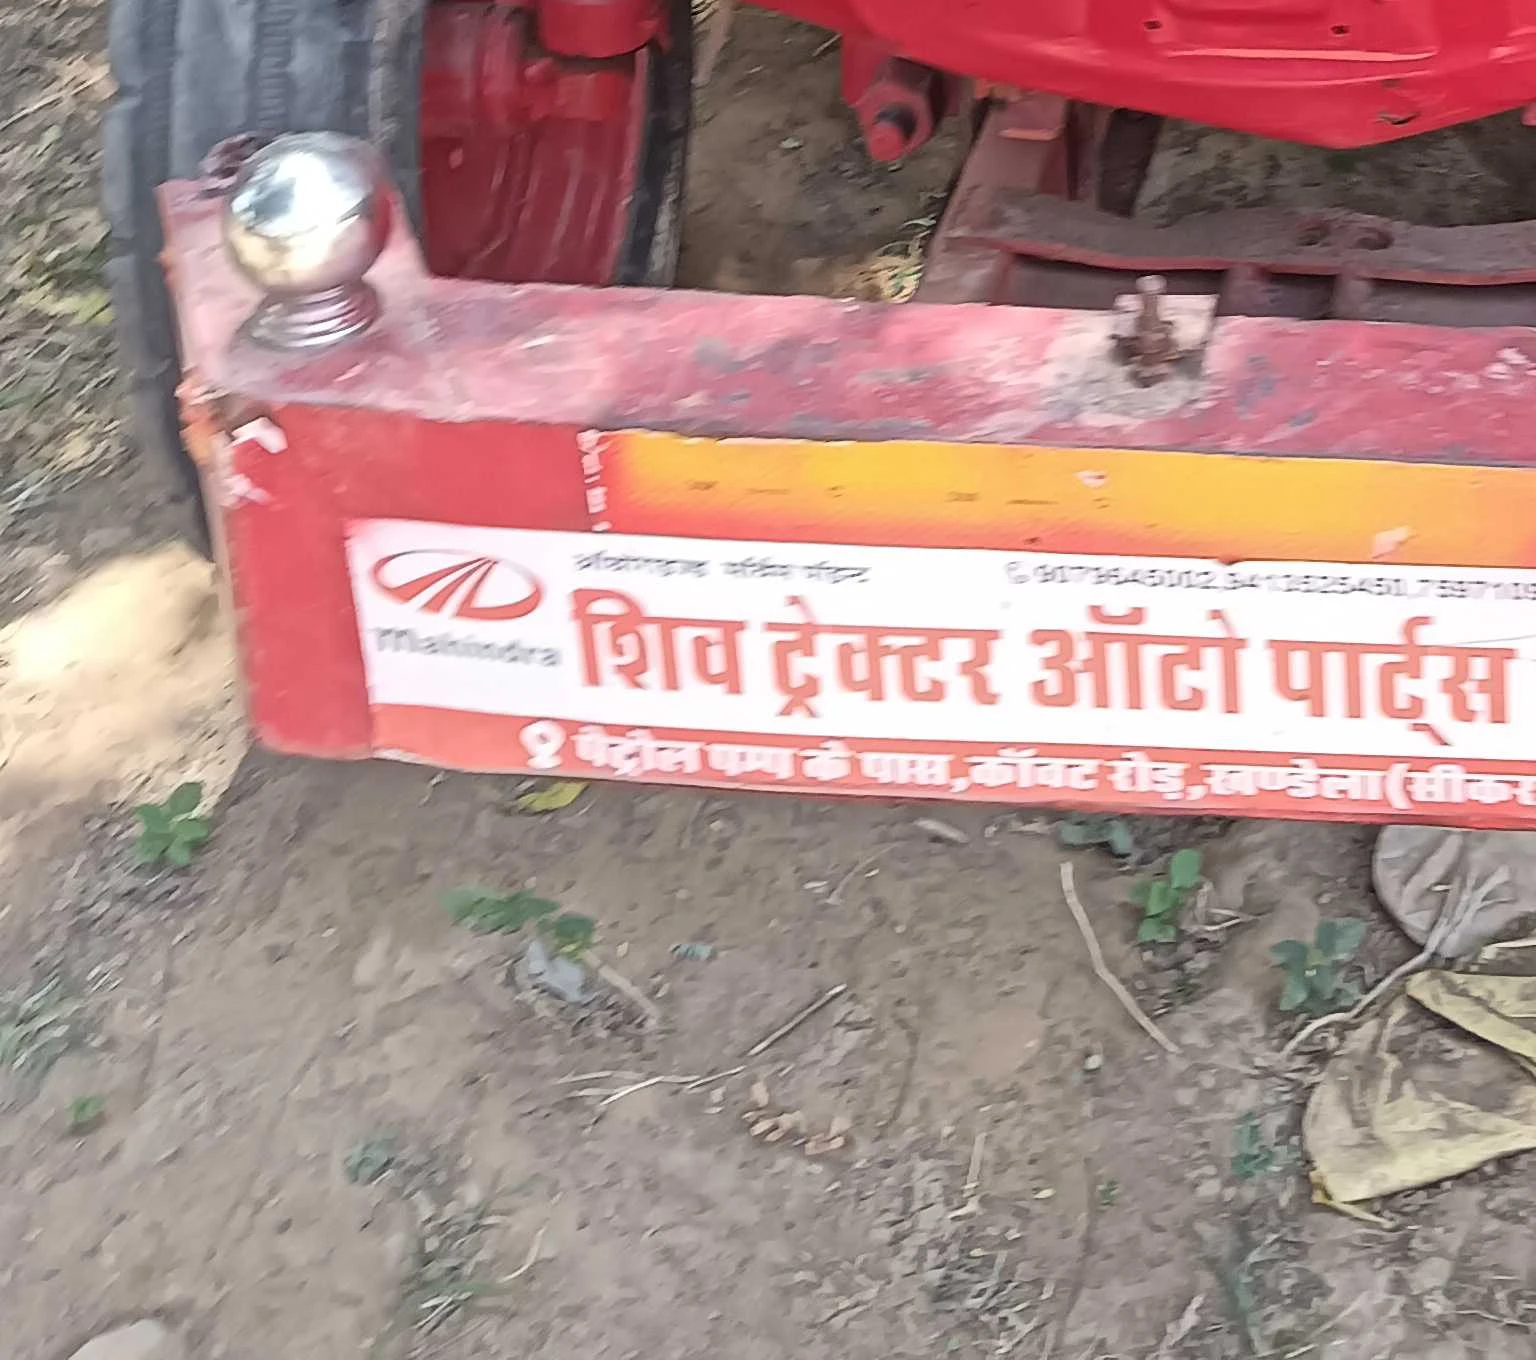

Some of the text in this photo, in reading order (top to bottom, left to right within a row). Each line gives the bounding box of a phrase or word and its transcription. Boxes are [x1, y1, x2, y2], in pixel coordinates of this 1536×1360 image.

[571, 588, 1518, 746] शिव ट्रेक्टर ऑटो पार्ट्स
[799, 740, 857, 782] के
